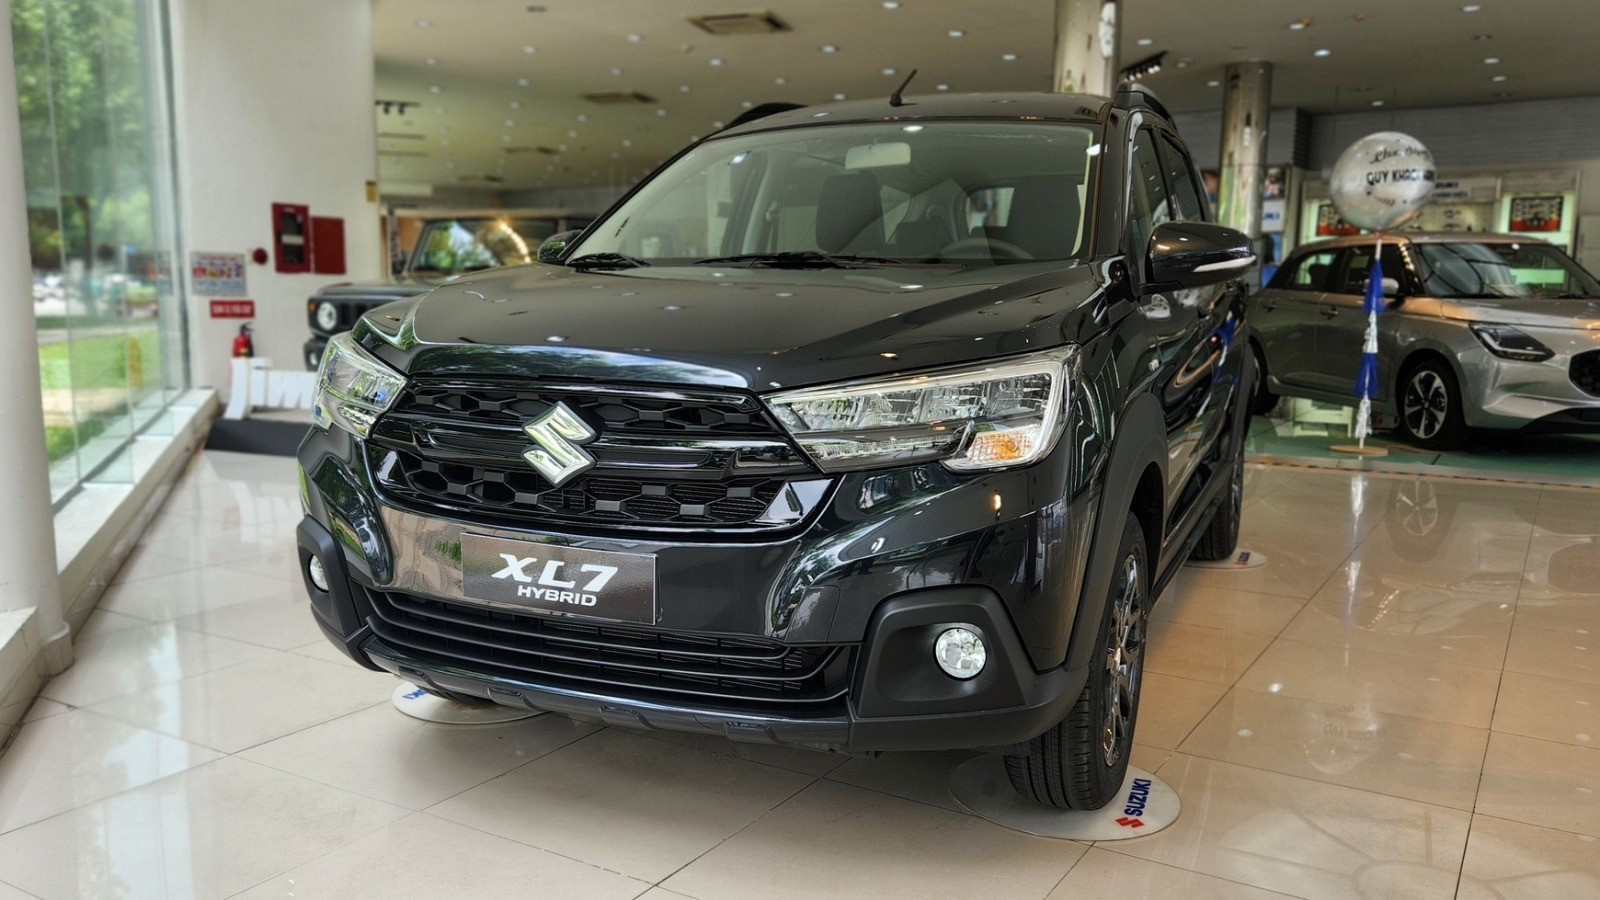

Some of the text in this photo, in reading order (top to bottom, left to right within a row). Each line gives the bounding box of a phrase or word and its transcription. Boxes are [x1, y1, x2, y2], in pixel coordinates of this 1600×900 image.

[491, 553, 618, 592] XL7
[517, 585, 597, 607] HYBRID
[1124, 778, 1152, 817] SUZUKI
